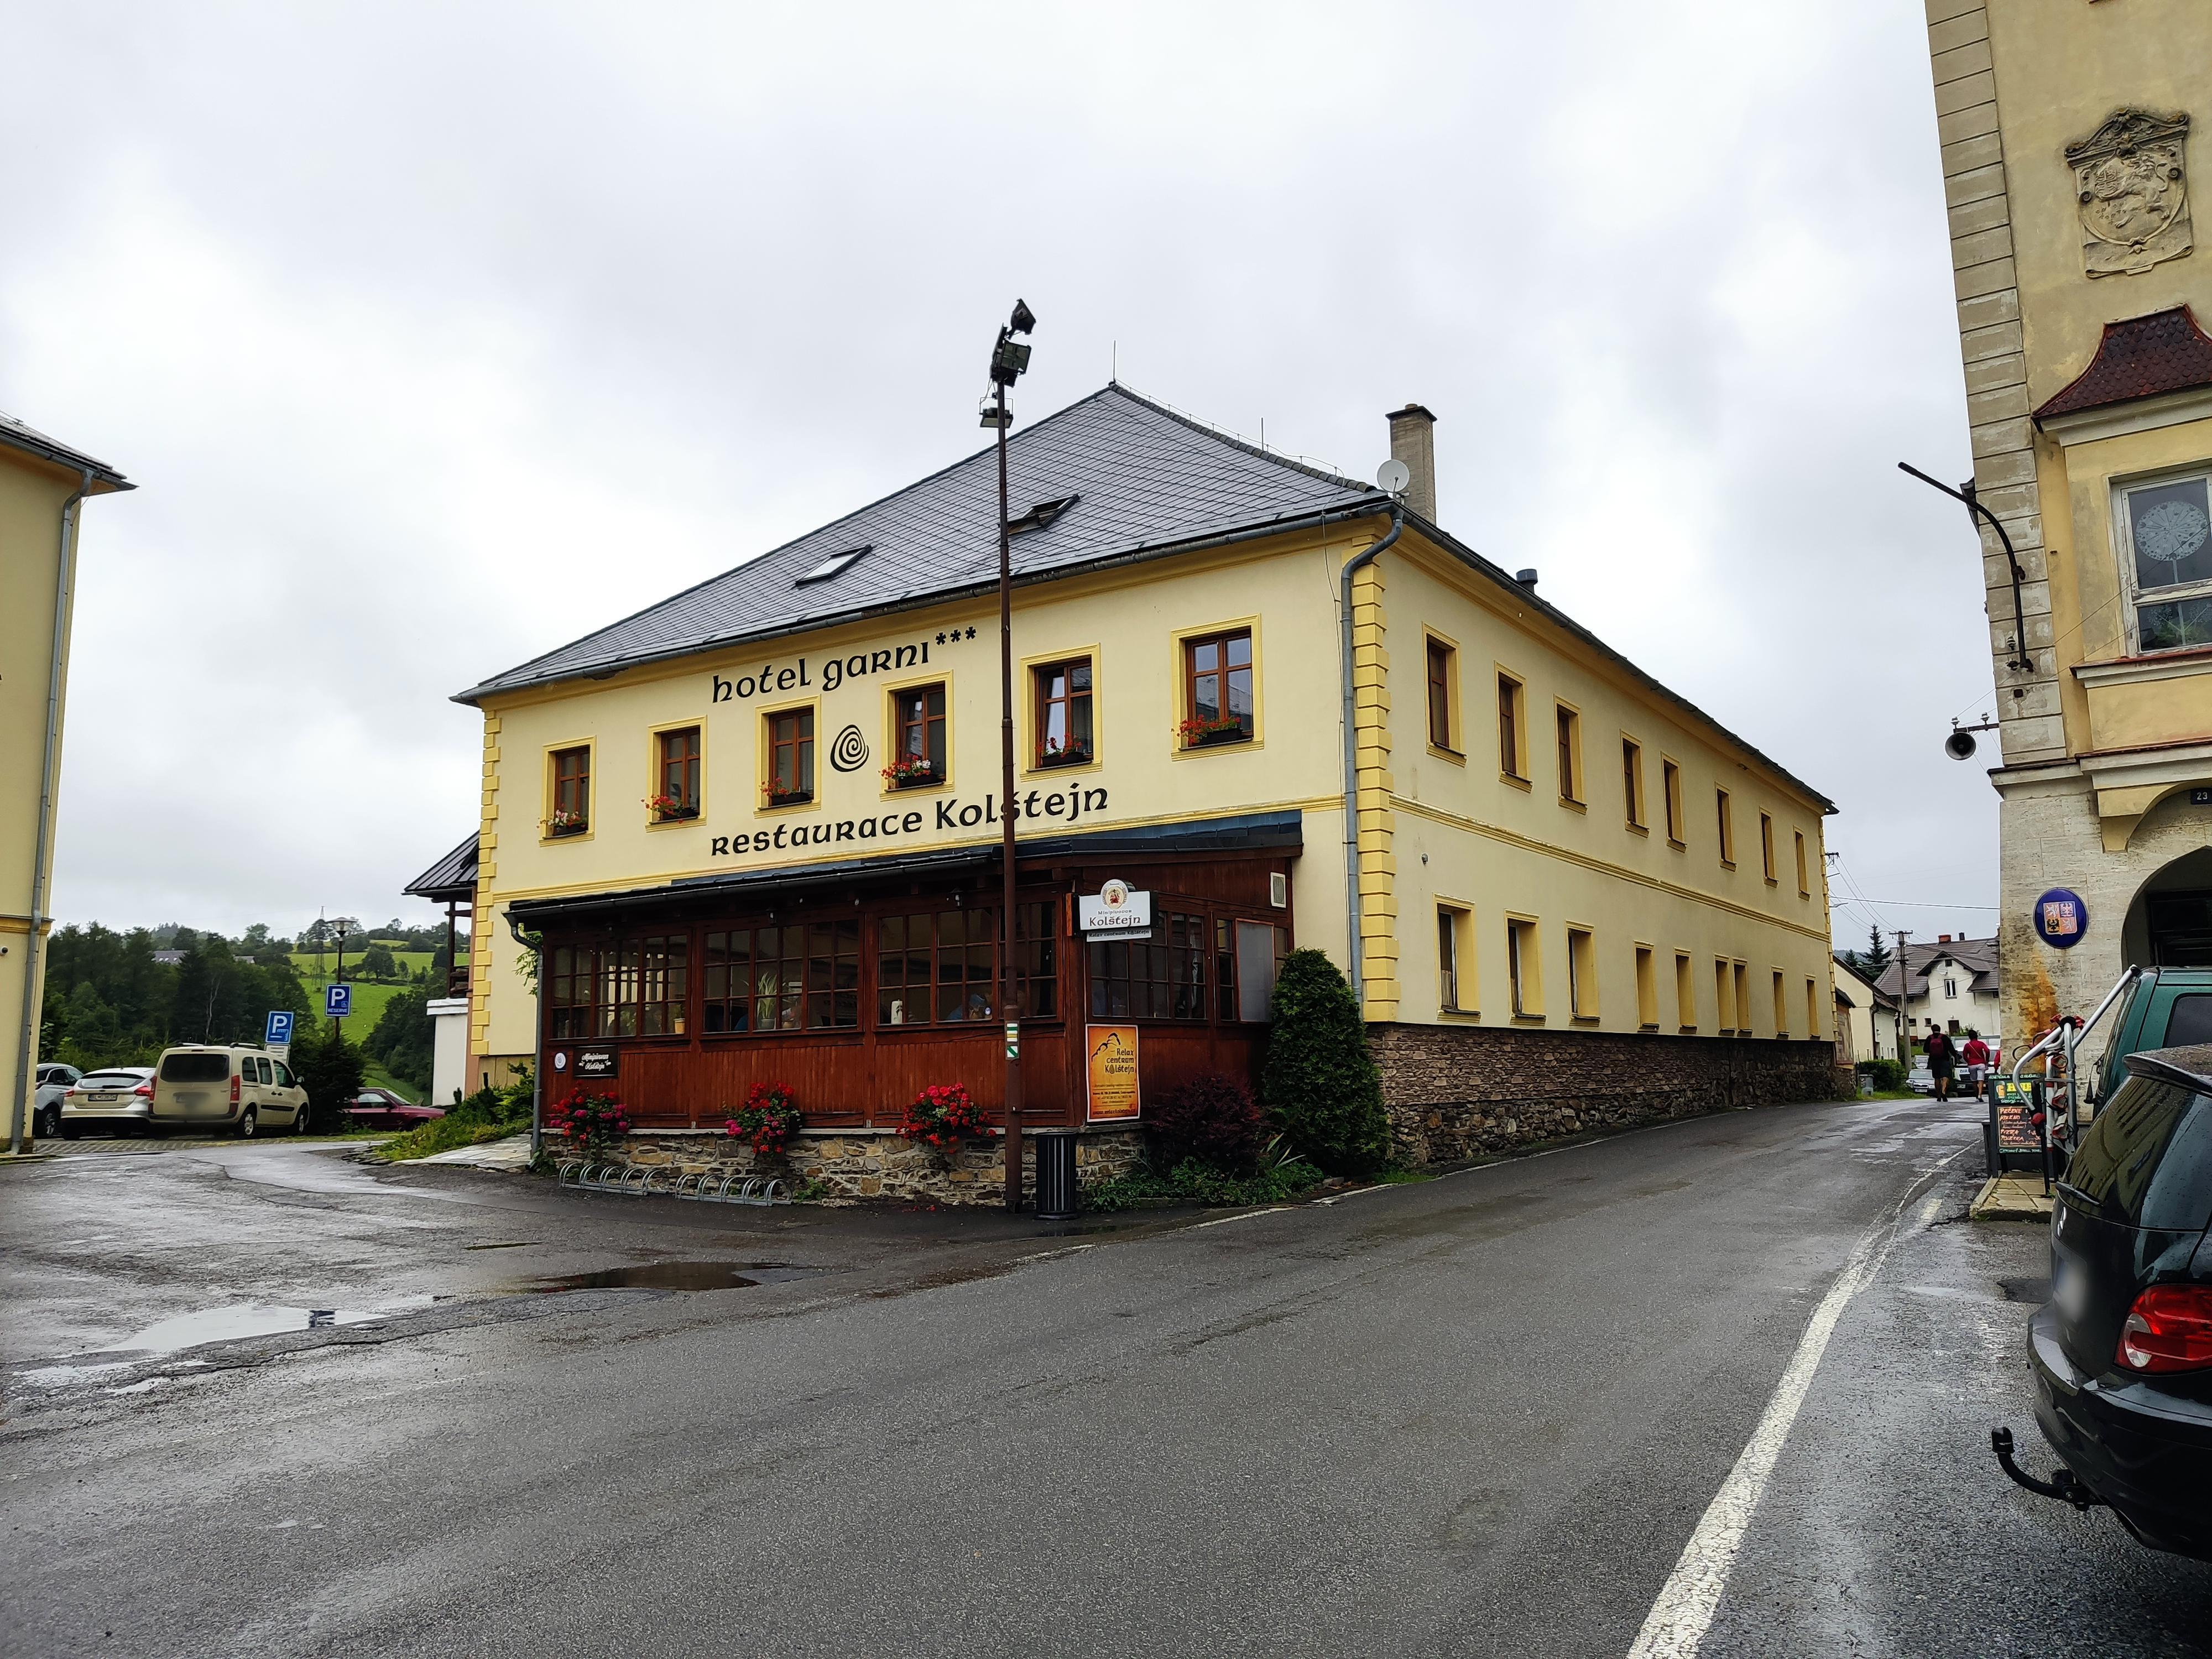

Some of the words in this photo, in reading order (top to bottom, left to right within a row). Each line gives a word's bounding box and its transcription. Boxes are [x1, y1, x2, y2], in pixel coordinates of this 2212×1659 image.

[712, 658, 812, 703] hotel
[2197, 791, 2208, 800] 23
[711, 812, 922, 856] restaurace
[1089, 915, 1141, 927] Kolštejn
[331, 988, 346, 1006] P
[272, 1015, 288, 1034] P
[1117, 1048, 1134, 1056] Relax
